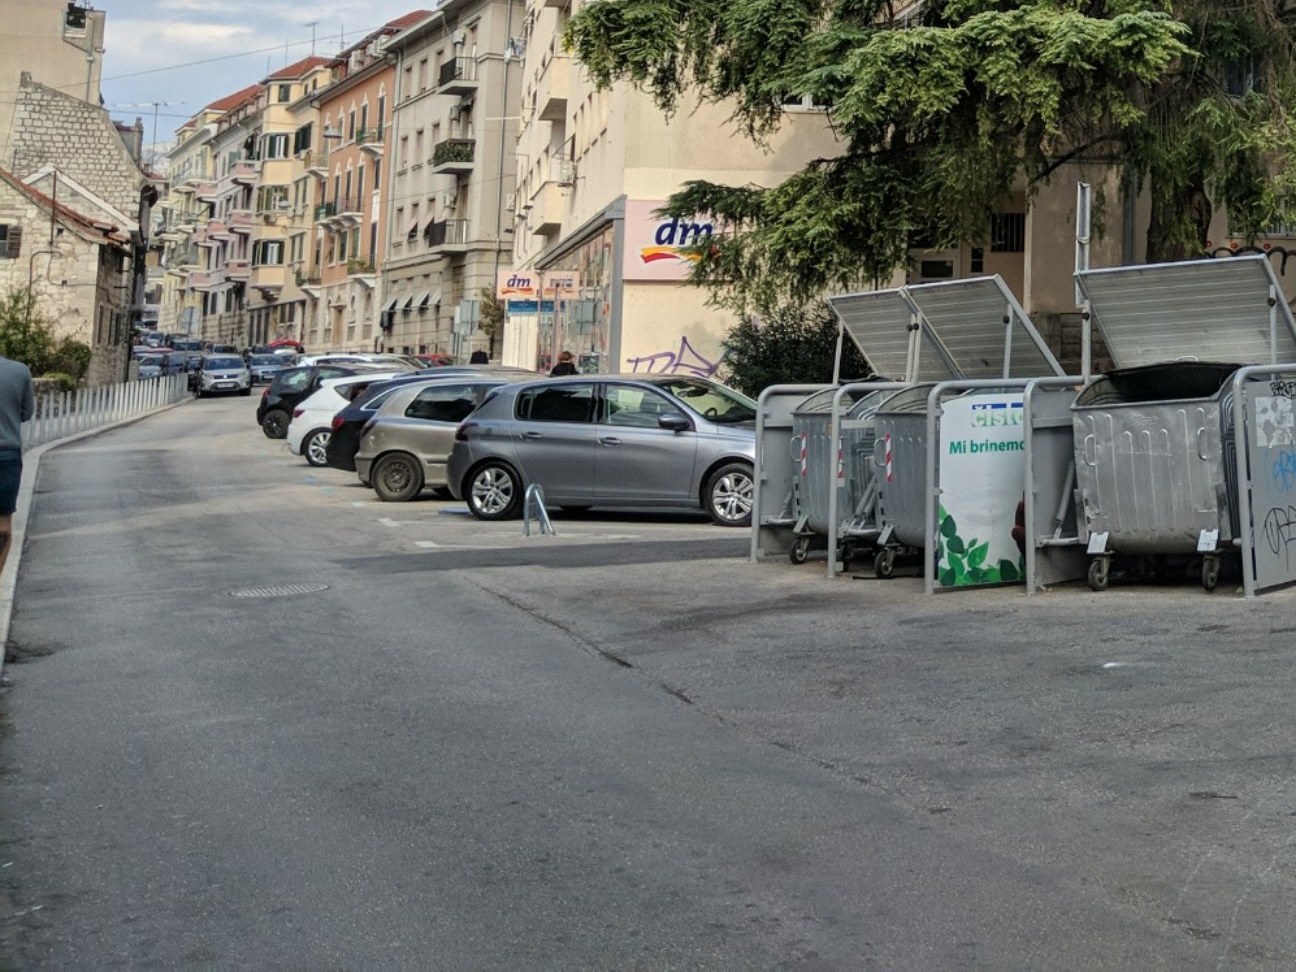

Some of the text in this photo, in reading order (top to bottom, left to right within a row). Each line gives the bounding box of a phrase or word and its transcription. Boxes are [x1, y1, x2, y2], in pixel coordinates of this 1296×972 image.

[655, 217, 713, 246] dm
[506, 274, 531, 288] dm
[949, 440, 967, 455] Mi
